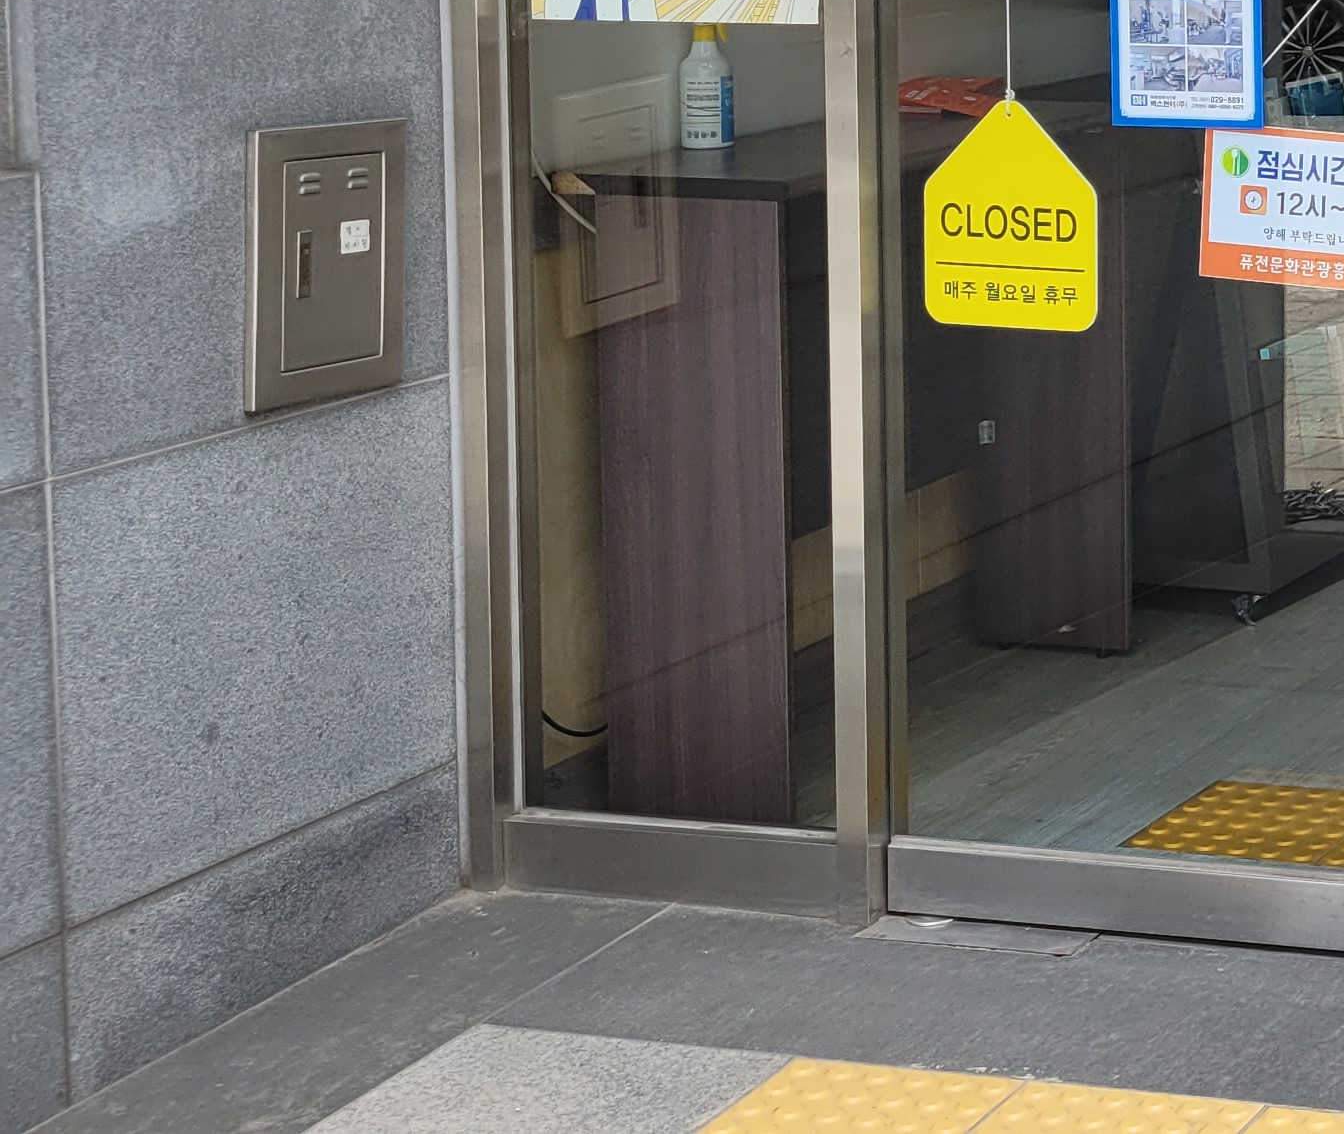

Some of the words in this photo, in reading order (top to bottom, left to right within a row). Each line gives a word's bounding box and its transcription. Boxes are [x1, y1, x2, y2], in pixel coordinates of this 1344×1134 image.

[940, 202, 1077, 243] CLOSED
[1263, 226, 1286, 242] 양해
[944, 280, 978, 300] 매주
[984, 281, 1036, 304] 월요일
[1043, 285, 1079, 306] 휴무
